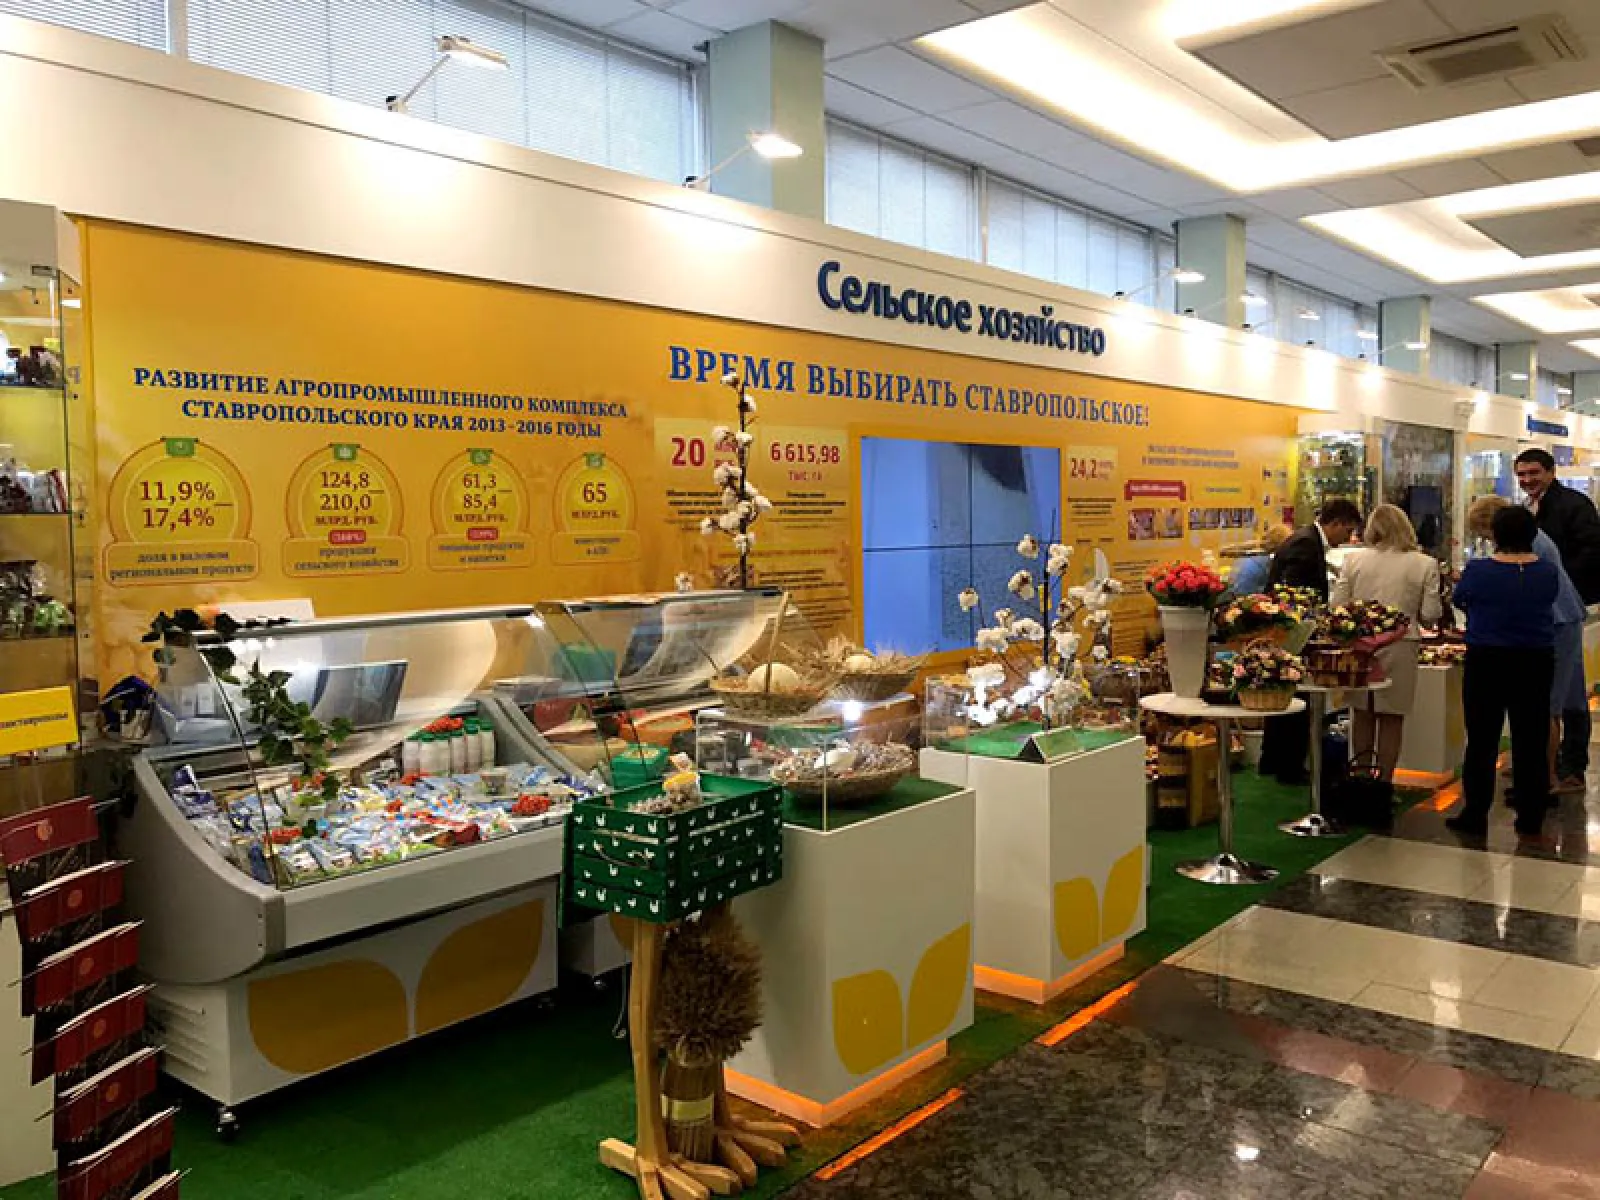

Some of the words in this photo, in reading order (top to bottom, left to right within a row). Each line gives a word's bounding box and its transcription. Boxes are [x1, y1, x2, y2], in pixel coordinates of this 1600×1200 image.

[817, 261, 972, 333] Сельское
[977, 305, 1106, 356] хозяйство
[133, 367, 269, 395] РАЗВИТИЕ
[274, 379, 523, 412] АГРОПРОМЫШЛЕННОГО
[527, 397, 628, 418] КОМПЛЕКСА
[669, 345, 795, 392] ВРЕМЯ
[807, 363, 957, 408] ВЫБИРАТЬ
[965, 383, 1149, 427] СТАВРОПОЛЬСКОЕ!
[181, 399, 409, 428] СТАВРОПОЛЬСКОГО
[413, 413, 464, 431] КРАЯ
[556, 421, 602, 438] ГОДЫ
[671, 437, 706, 467] 20
[139, 480, 215, 506] 11,9%
[321, 471, 370, 492] 124,8
[463, 473, 497, 492] 61,3
[583, 482, 608, 504] 65
[320, 493, 372, 513] 210,0
[463, 493, 497, 512] 85,4
[142, 507, 215, 532] 17,4%
